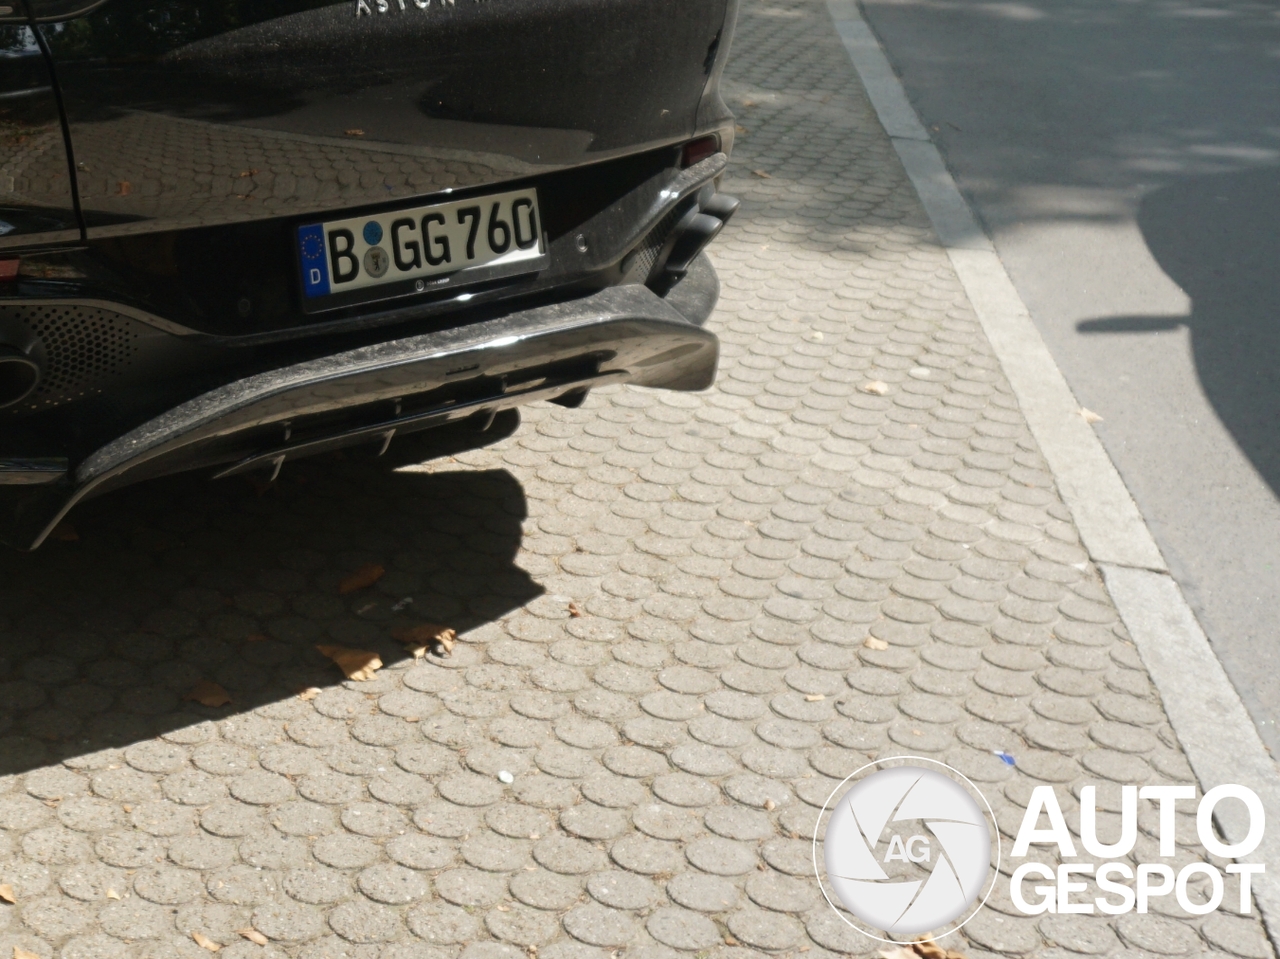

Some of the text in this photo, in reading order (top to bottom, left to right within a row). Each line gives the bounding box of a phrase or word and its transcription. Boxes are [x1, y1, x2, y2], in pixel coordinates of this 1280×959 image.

[328, 197, 538, 285] B GG 760
[310, 268, 321, 285] D
